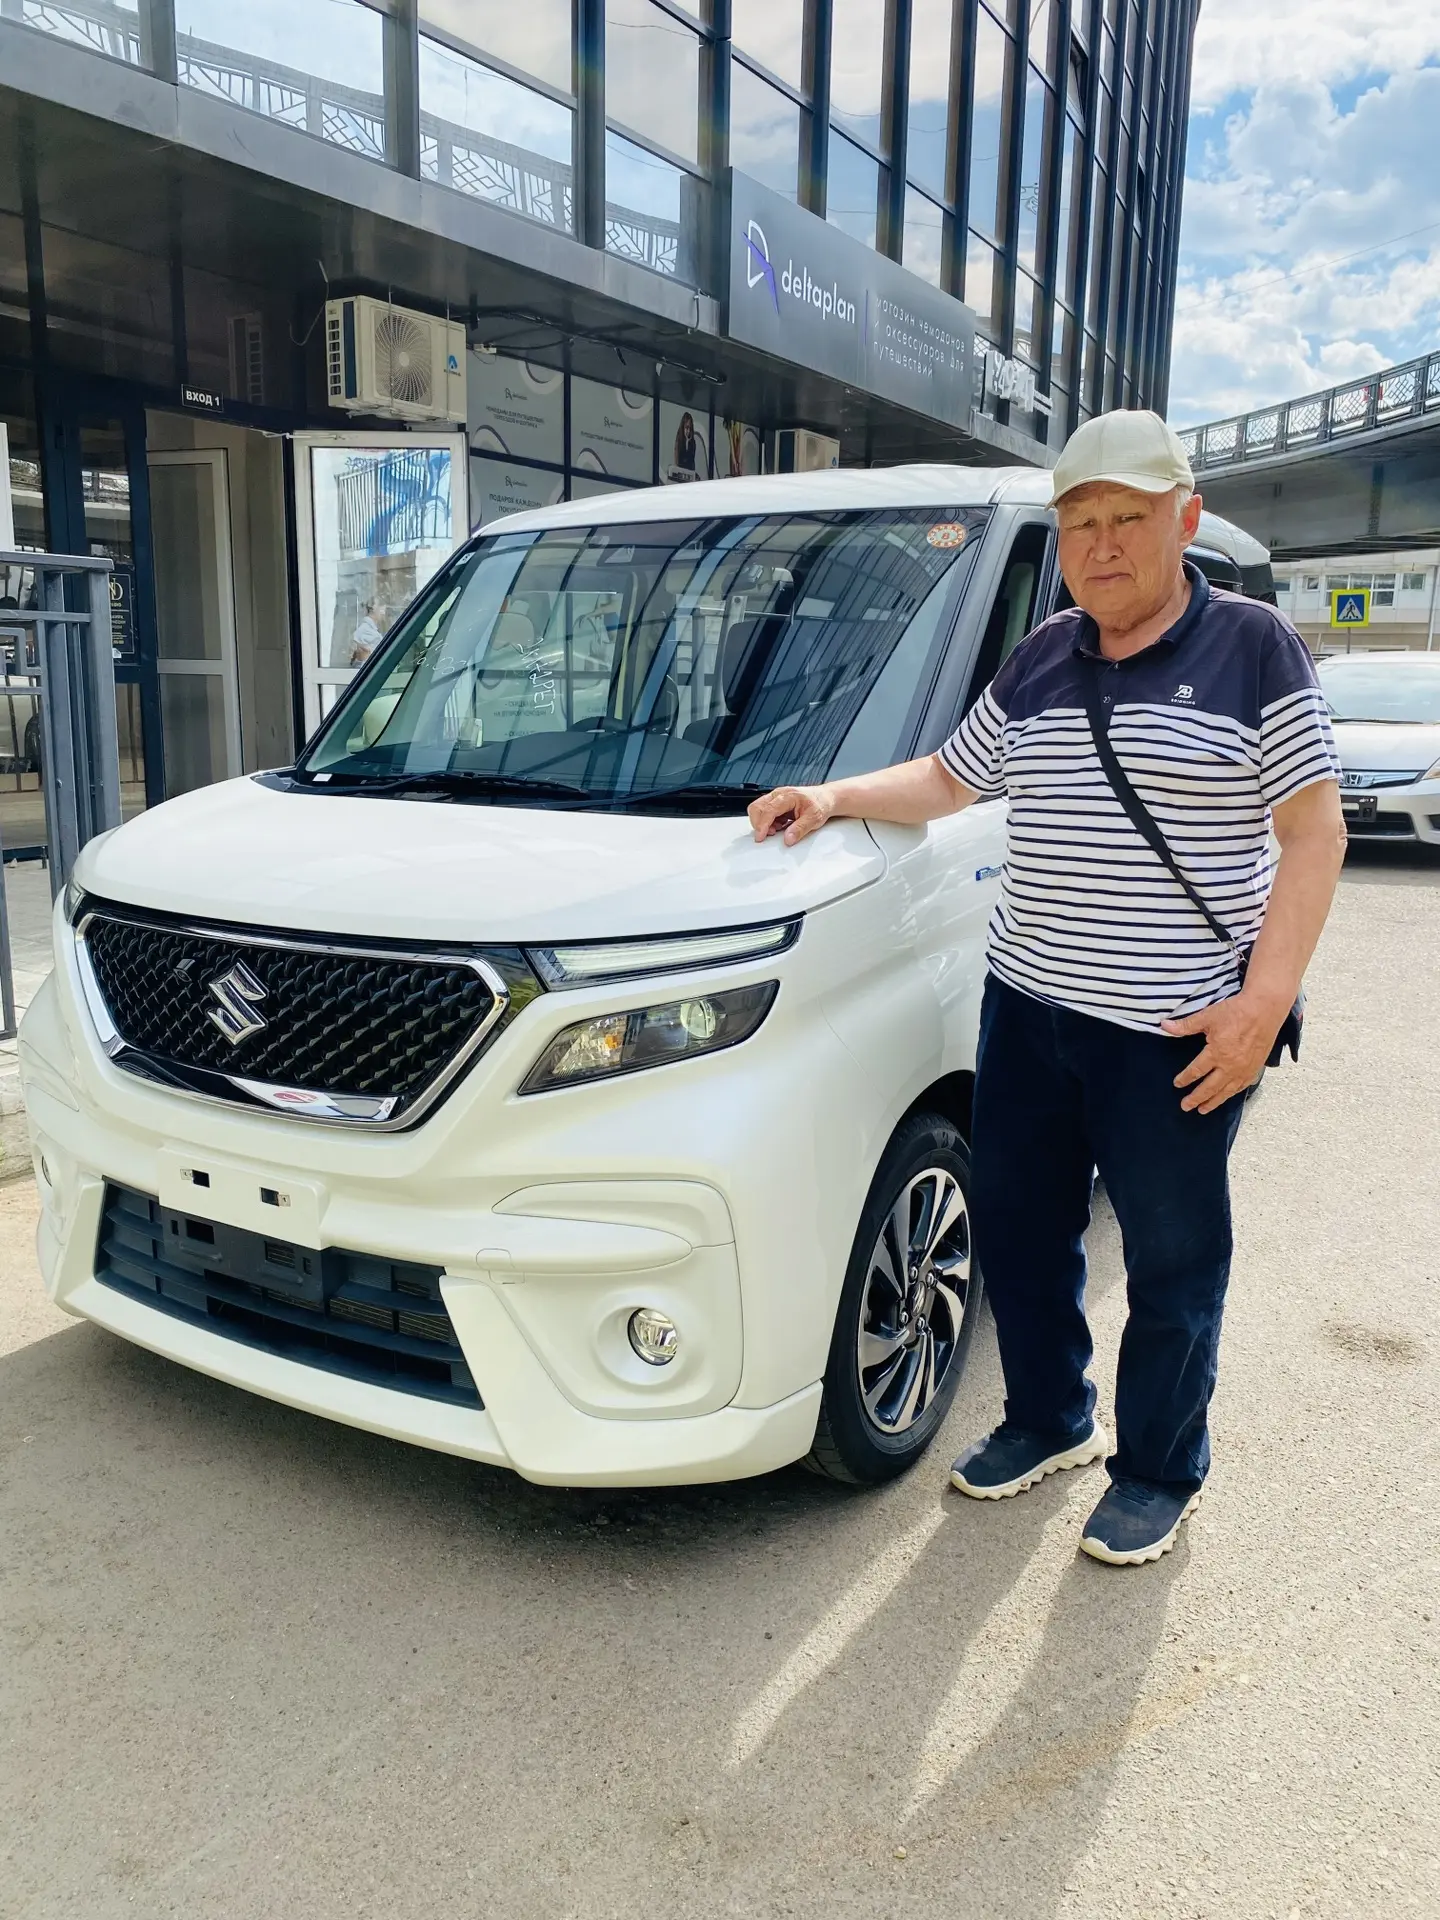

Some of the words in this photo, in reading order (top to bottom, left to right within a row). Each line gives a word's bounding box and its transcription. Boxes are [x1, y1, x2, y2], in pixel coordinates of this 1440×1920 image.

[781, 260, 856, 324] deltaplan
[186, 390, 213, 406] ВХОД
[215, 396, 220, 406] 1
